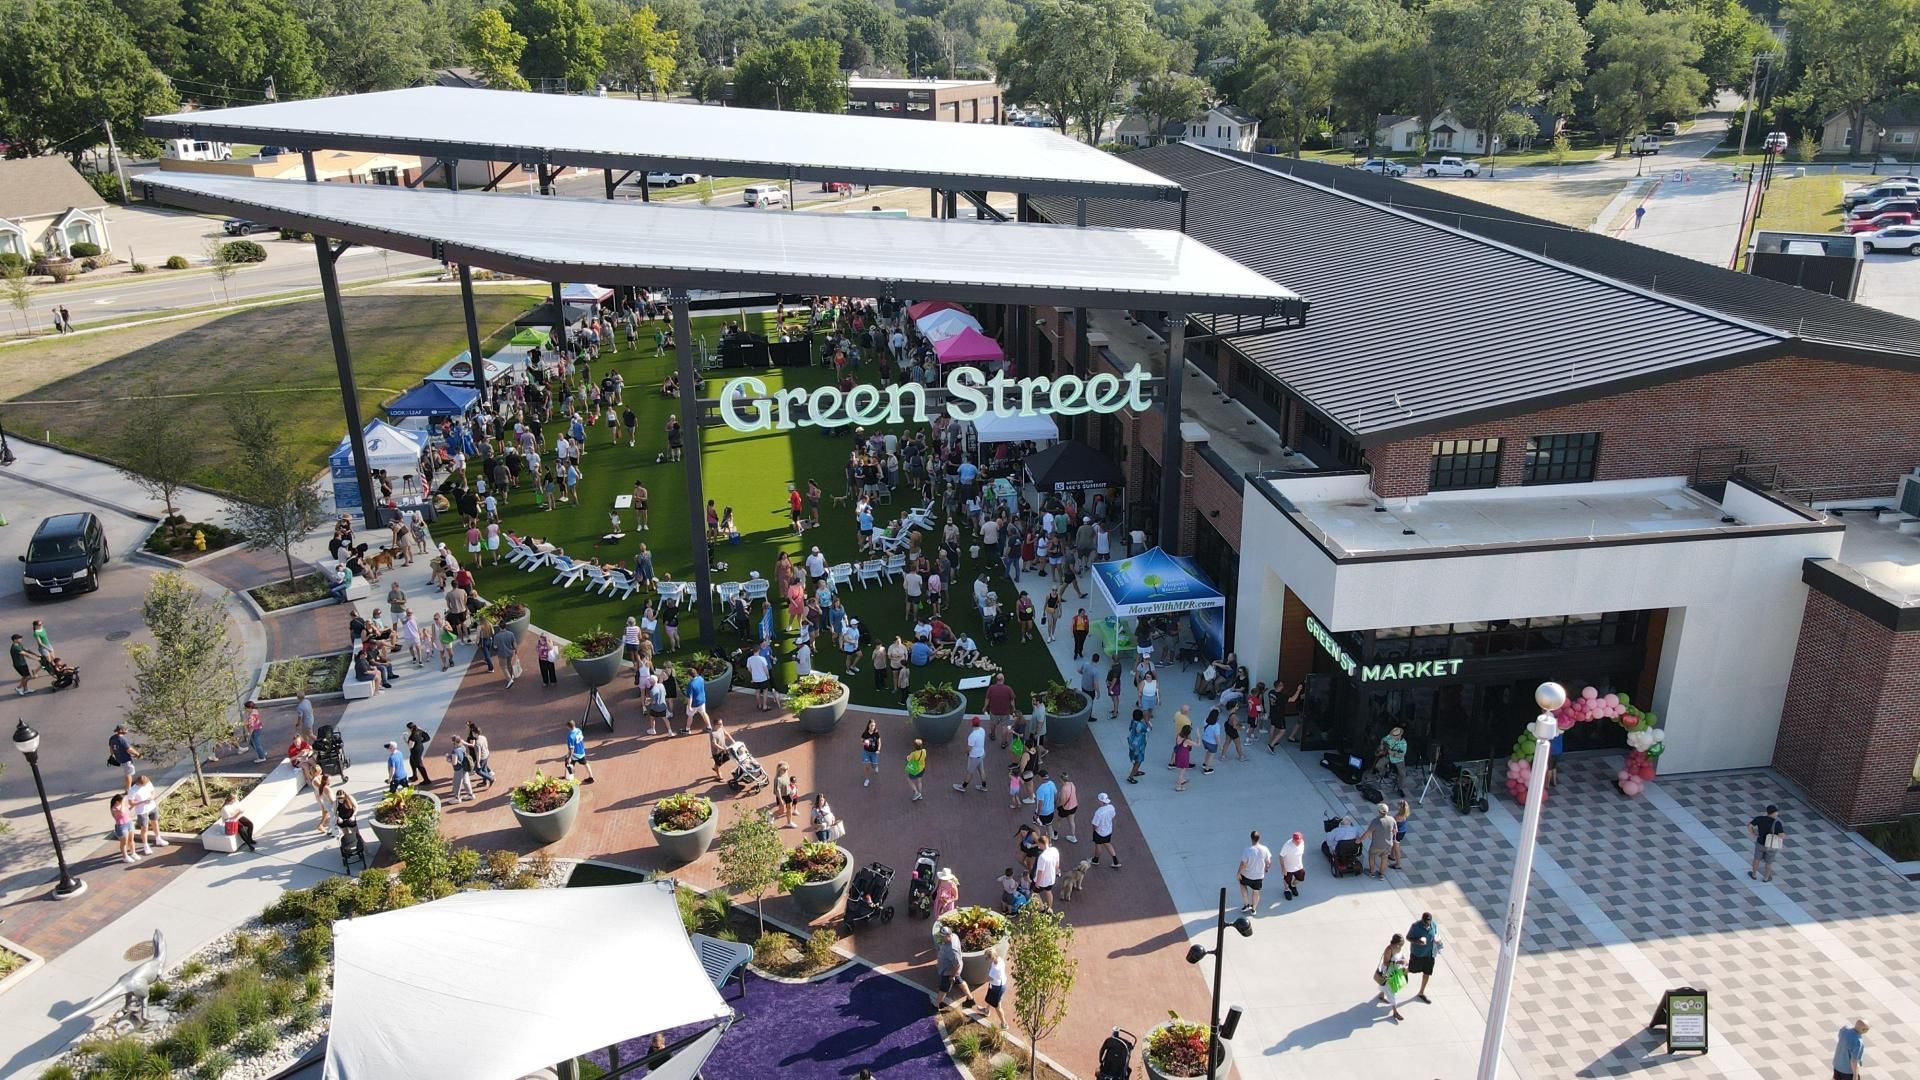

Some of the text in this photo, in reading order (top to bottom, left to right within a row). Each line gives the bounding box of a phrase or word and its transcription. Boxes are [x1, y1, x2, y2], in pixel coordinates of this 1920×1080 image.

[720, 362, 1152, 432] Green Street
[1128, 600, 1215, 614] MoveWithMPR.com
[1306, 616, 1357, 676] GREEN ST
[1361, 659, 1463, 682] MARKET
